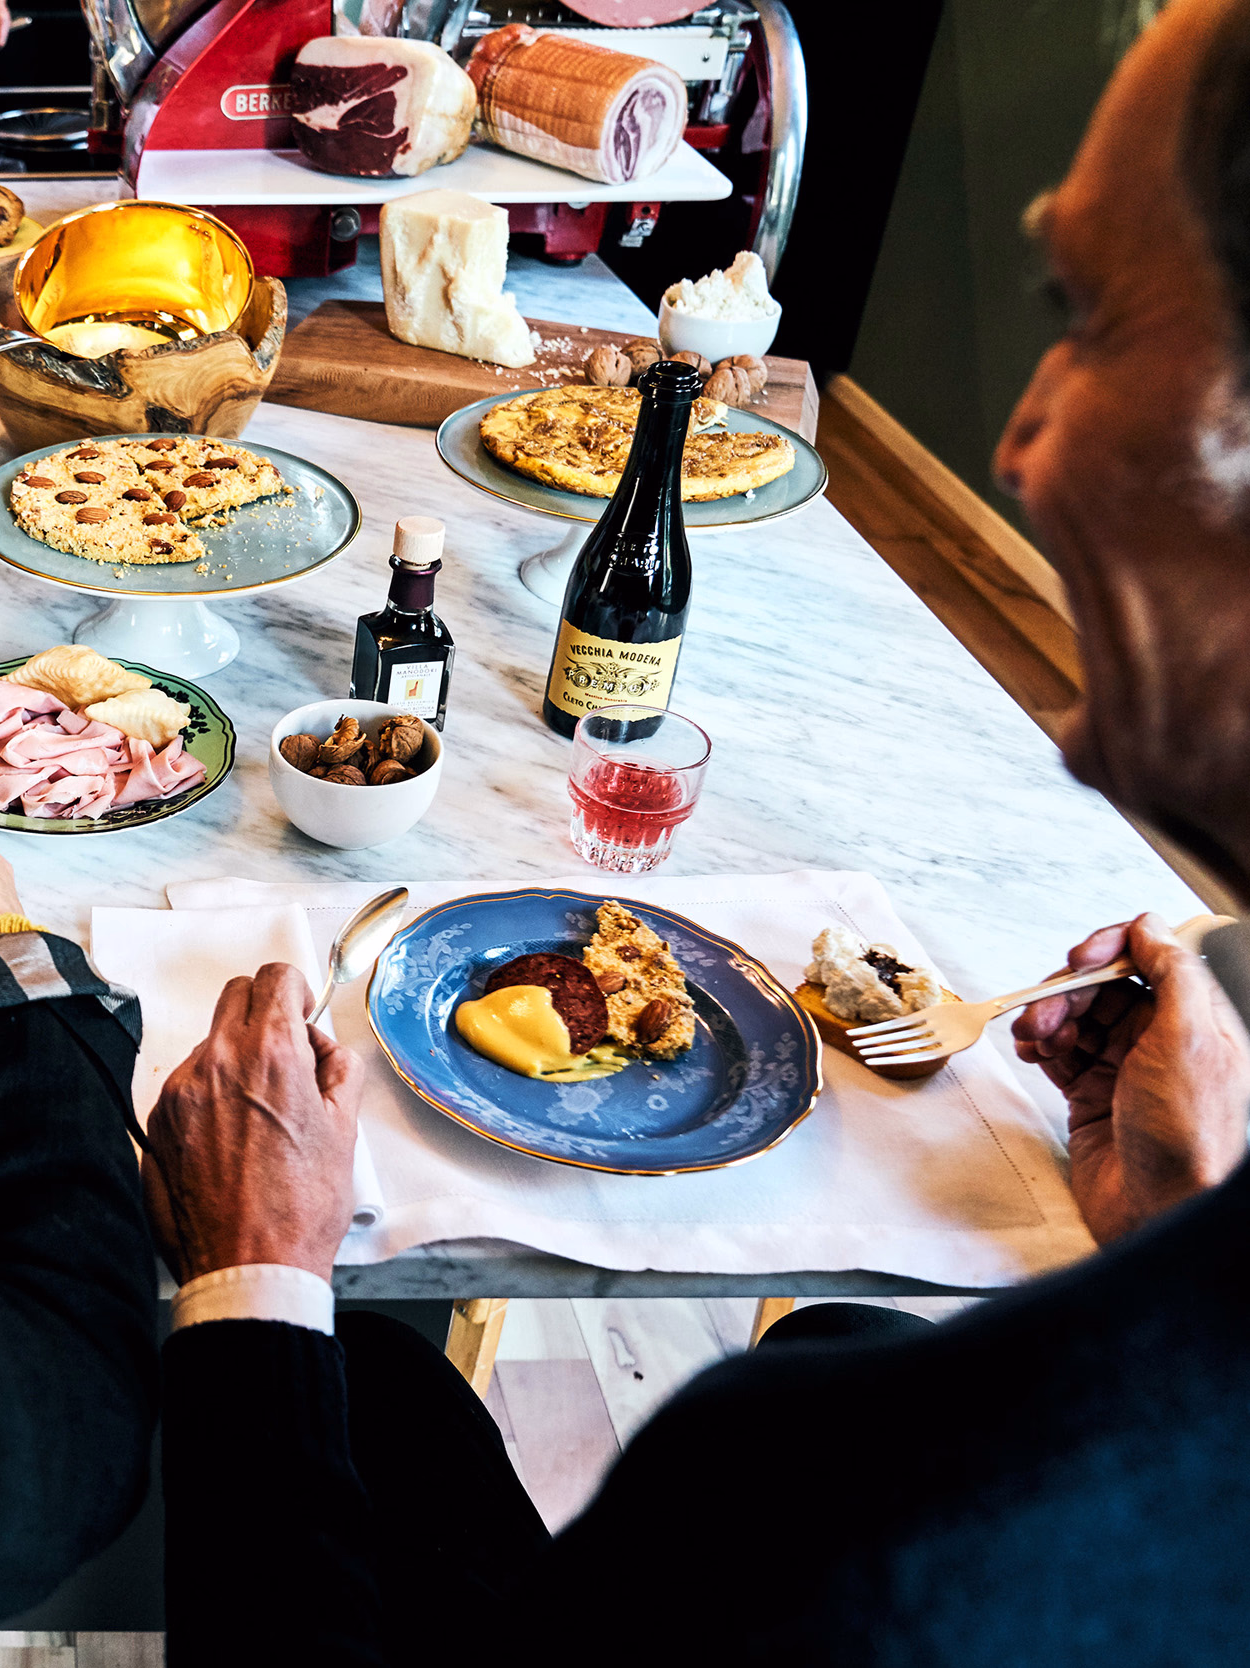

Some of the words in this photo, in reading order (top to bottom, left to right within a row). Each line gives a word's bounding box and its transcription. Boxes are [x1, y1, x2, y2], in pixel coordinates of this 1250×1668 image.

[236, 92, 291, 113] BERKE
[570, 644, 613, 658] VECCHIA
[618, 650, 661, 666] MODENA
[568, 669, 652, 691] PREMIUM
